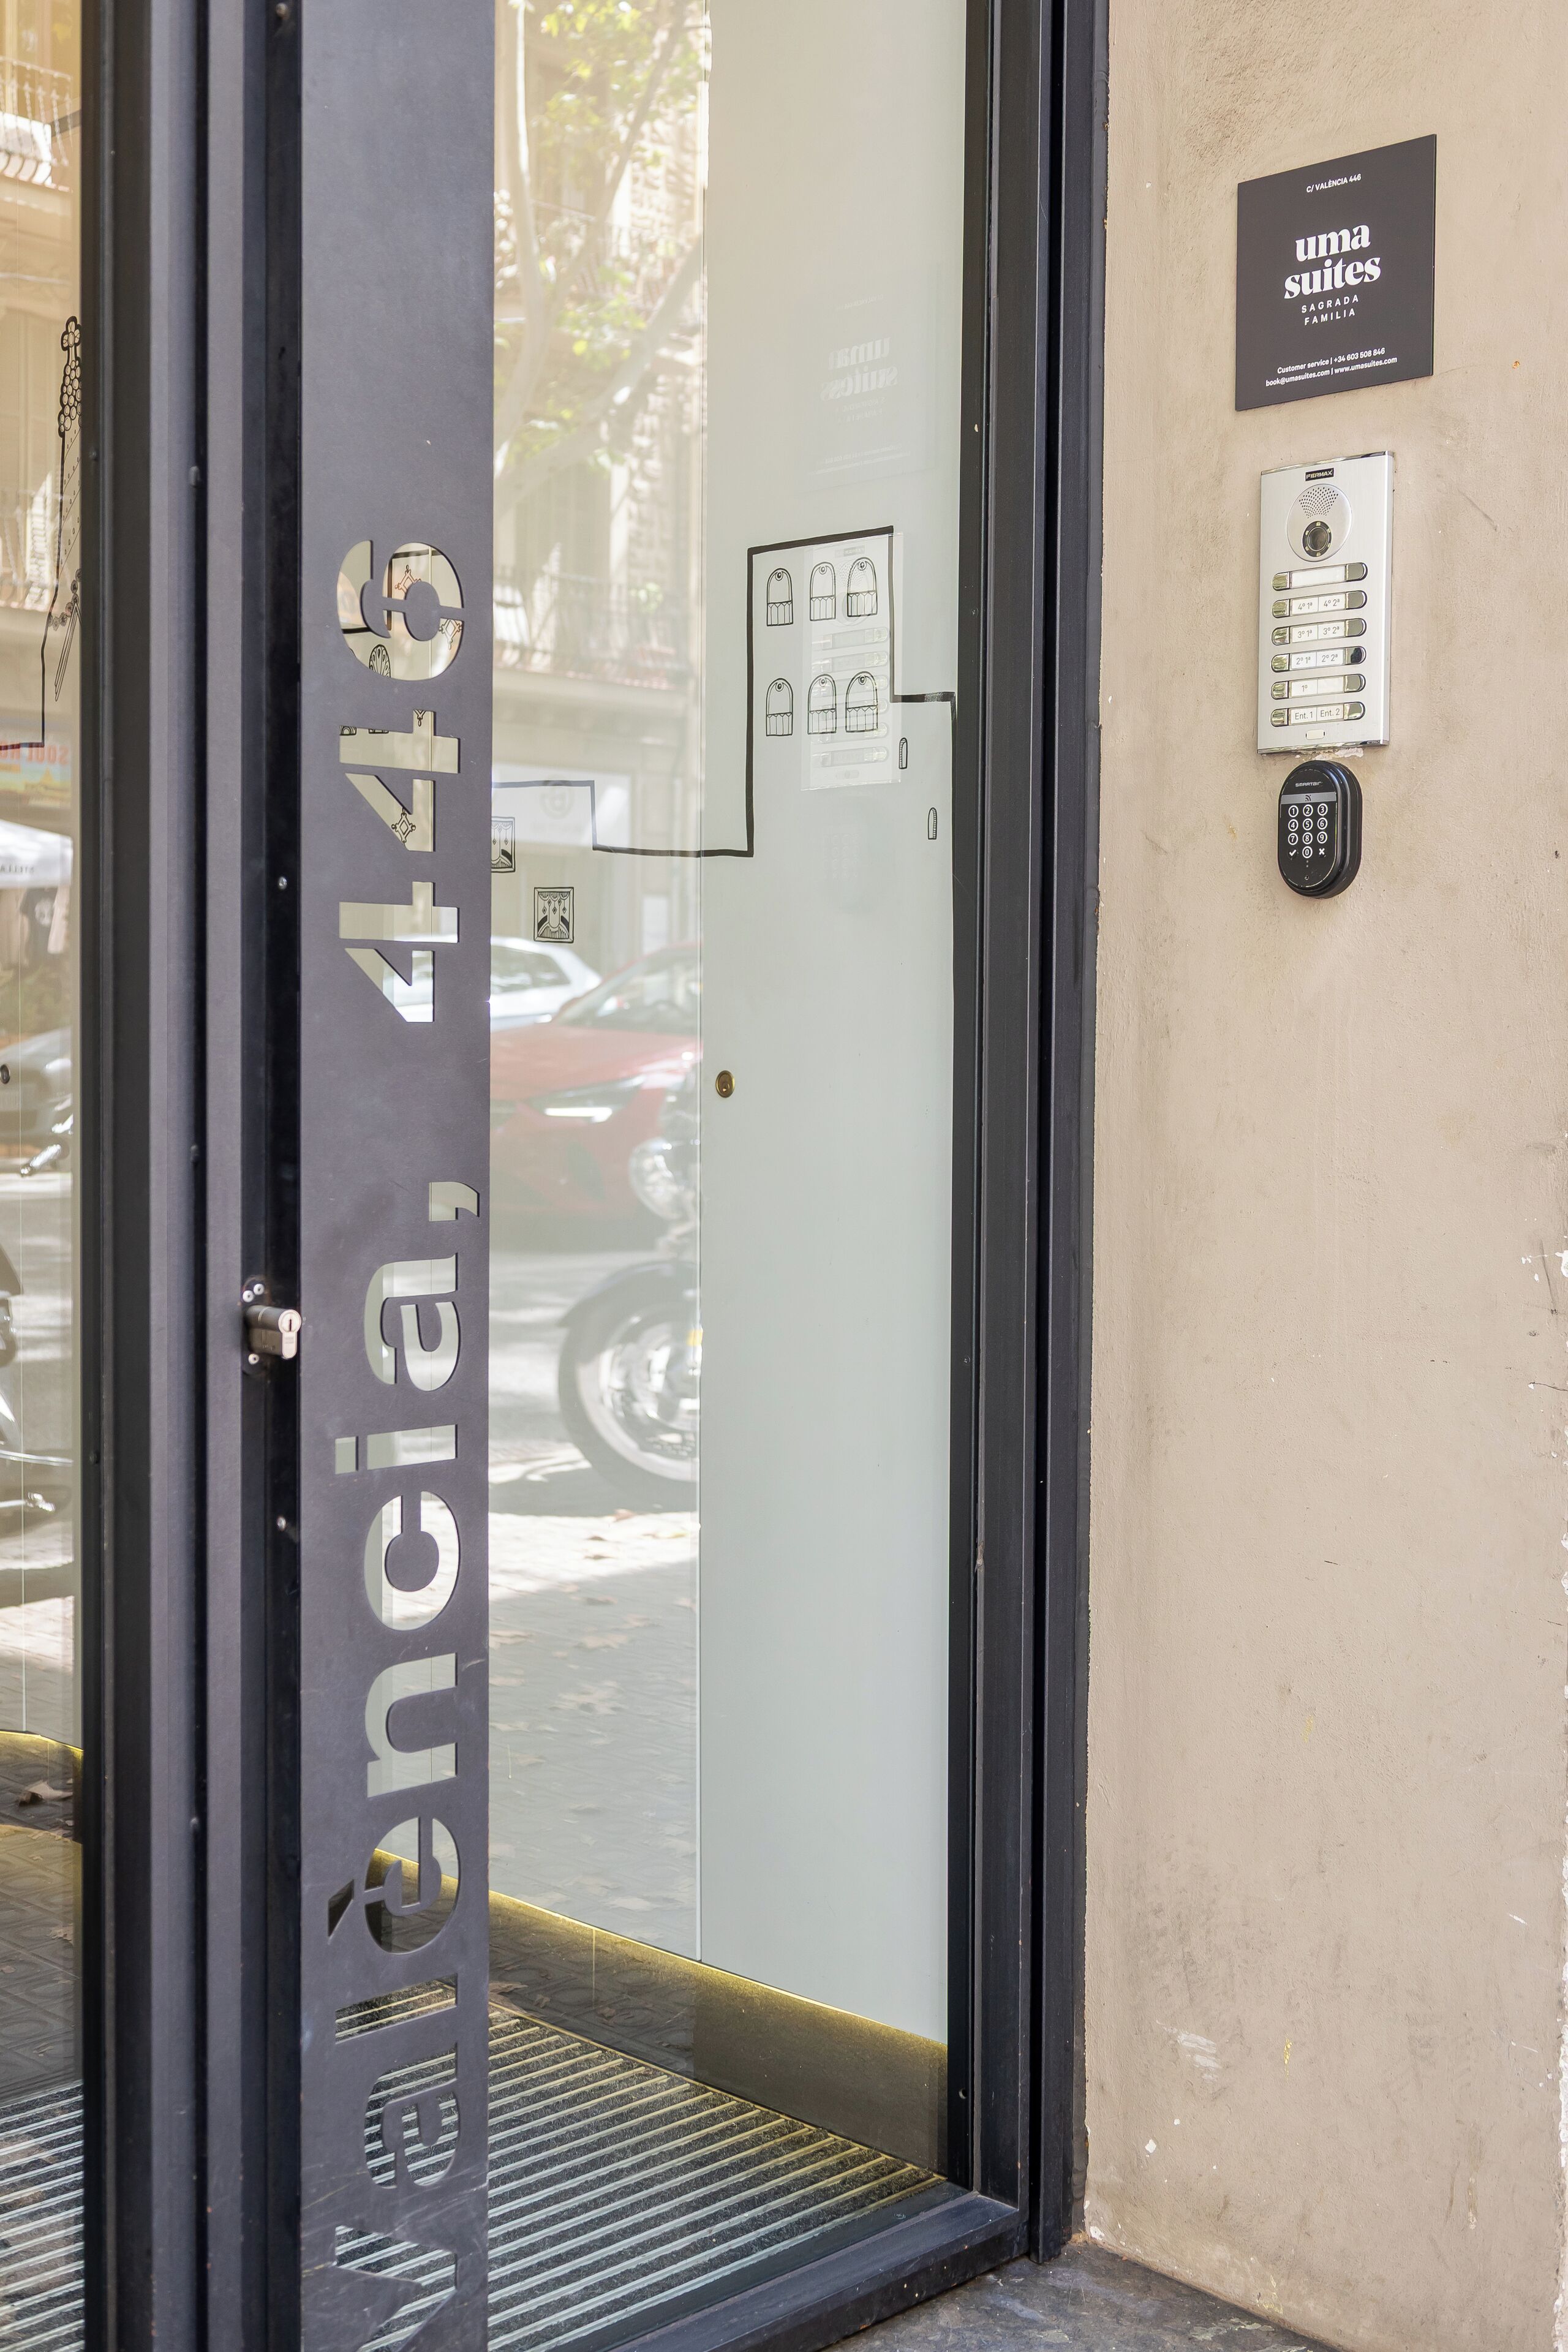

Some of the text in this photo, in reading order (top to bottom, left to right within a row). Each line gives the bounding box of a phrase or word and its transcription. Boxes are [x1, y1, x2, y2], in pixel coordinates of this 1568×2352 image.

[1306, 173, 1362, 193] C/ VALÈNCIA 446
[1295, 225, 1371, 262] uma
[1284, 257, 1381, 300] suites
[1301, 294, 1359, 314] SAGRADA
[1304, 308, 1355, 326] FAMILIA
[1265, 370, 1330, 387] book@umasuites.com
[1334, 357, 1397, 374] www.umasuites.com
[1277, 364, 1306, 374] Customer
[1307, 359, 1329, 369] service
[1333, 355, 1346, 363] +34
[1346, 353, 1359, 361] 603
[1359, 350, 1372, 359] 508
[1373, 347, 1385, 356] 846
[1306, 469, 1333, 479] FERMAX
[336, 538, 466, 1024] 446
